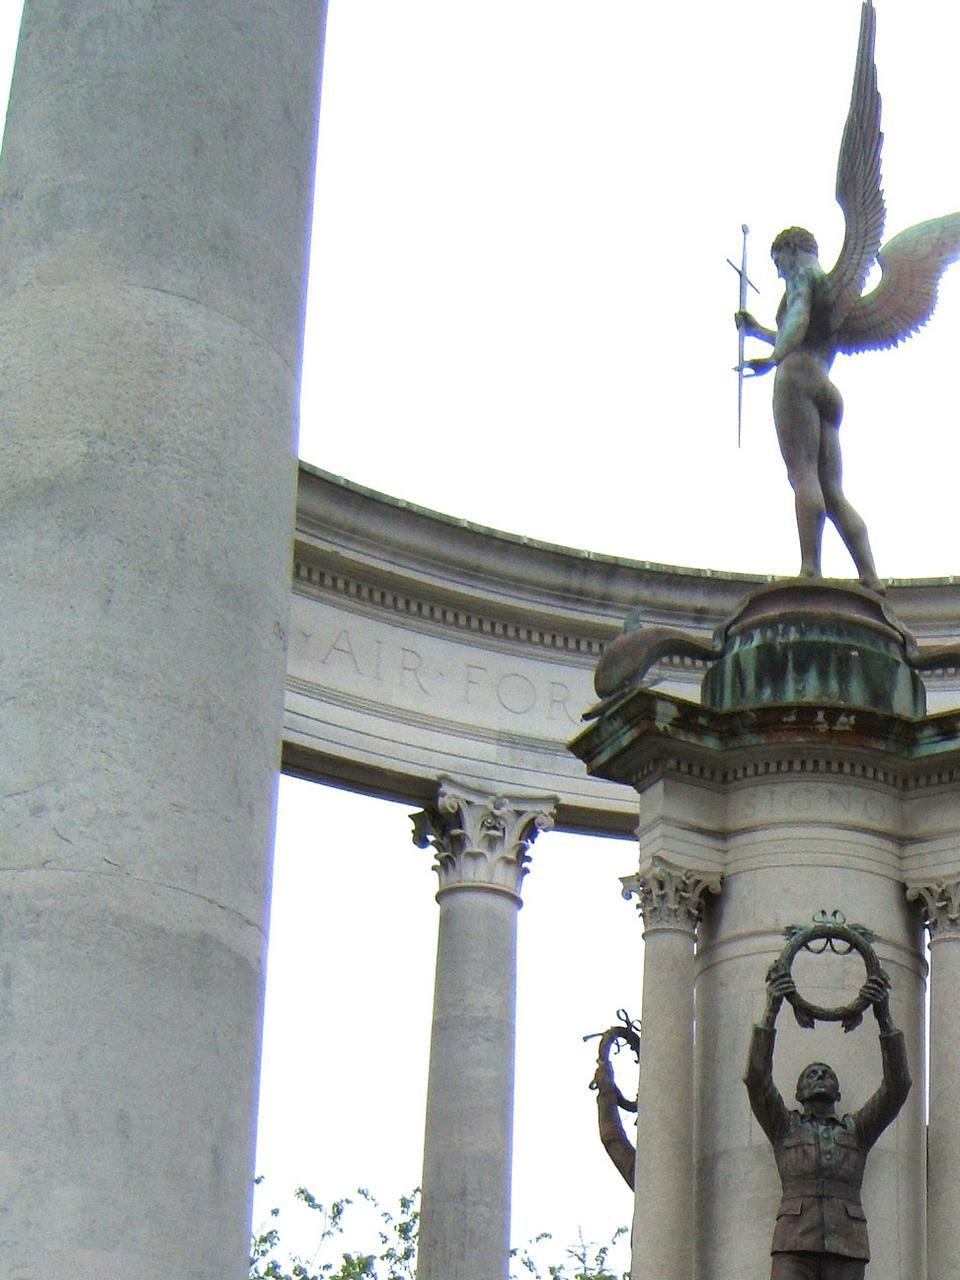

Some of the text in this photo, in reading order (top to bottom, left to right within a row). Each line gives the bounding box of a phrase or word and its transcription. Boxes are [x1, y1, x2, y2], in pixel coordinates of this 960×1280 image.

[317, 629, 581, 727] AIR FOR
[741, 786, 885, 821] SIGNO
